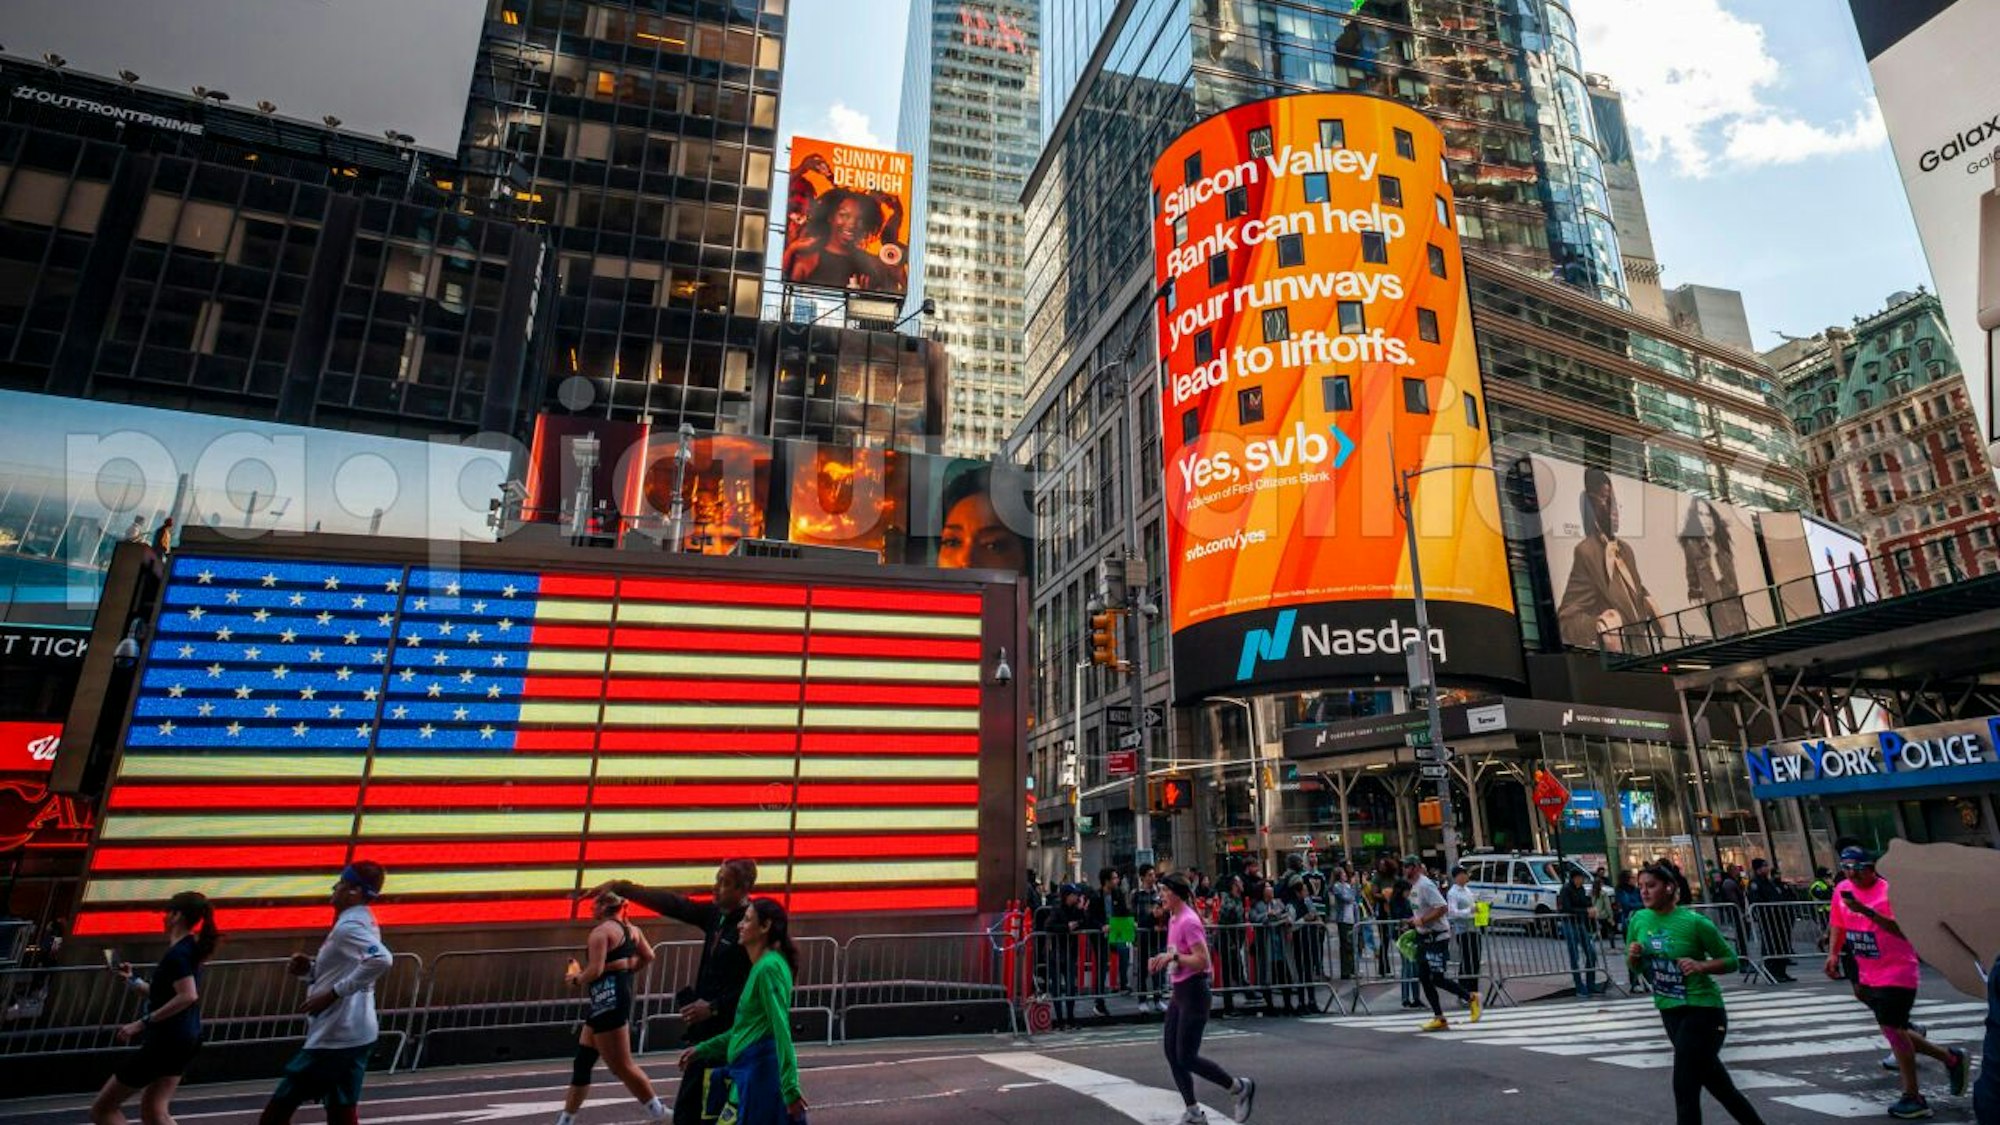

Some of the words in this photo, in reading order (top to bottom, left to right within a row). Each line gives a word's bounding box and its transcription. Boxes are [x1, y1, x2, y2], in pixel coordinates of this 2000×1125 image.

[13, 84, 205, 136] #OUTFRONTPRIME
[832, 147, 886, 171] SUNNY
[889, 156, 906, 175] IN
[1919, 115, 2000, 172] Galax
[833, 166, 903, 194] DENBIGH
[1163, 160, 1259, 228] Silicon
[1266, 142, 1379, 182] Valley
[1166, 223, 1239, 280] Bank
[1241, 208, 1315, 247] can
[1321, 202, 1406, 245] help
[1168, 287, 1230, 352] your
[1233, 270, 1405, 314] runways
[1172, 348, 1229, 407] lead
[1233, 345, 1274, 379] to
[1281, 328, 1416, 370] liftoffs.
[1179, 449, 1241, 494] Yes,
[1244, 421, 1329, 472] svb
[1232, 481, 1255, 496] First
[1299, 471, 1331, 484] Bank
[1185, 529, 1267, 562] svb.com/yes
[1302, 619, 1448, 664] Nasdaq
[1505, 893, 1530, 905] NYPD
